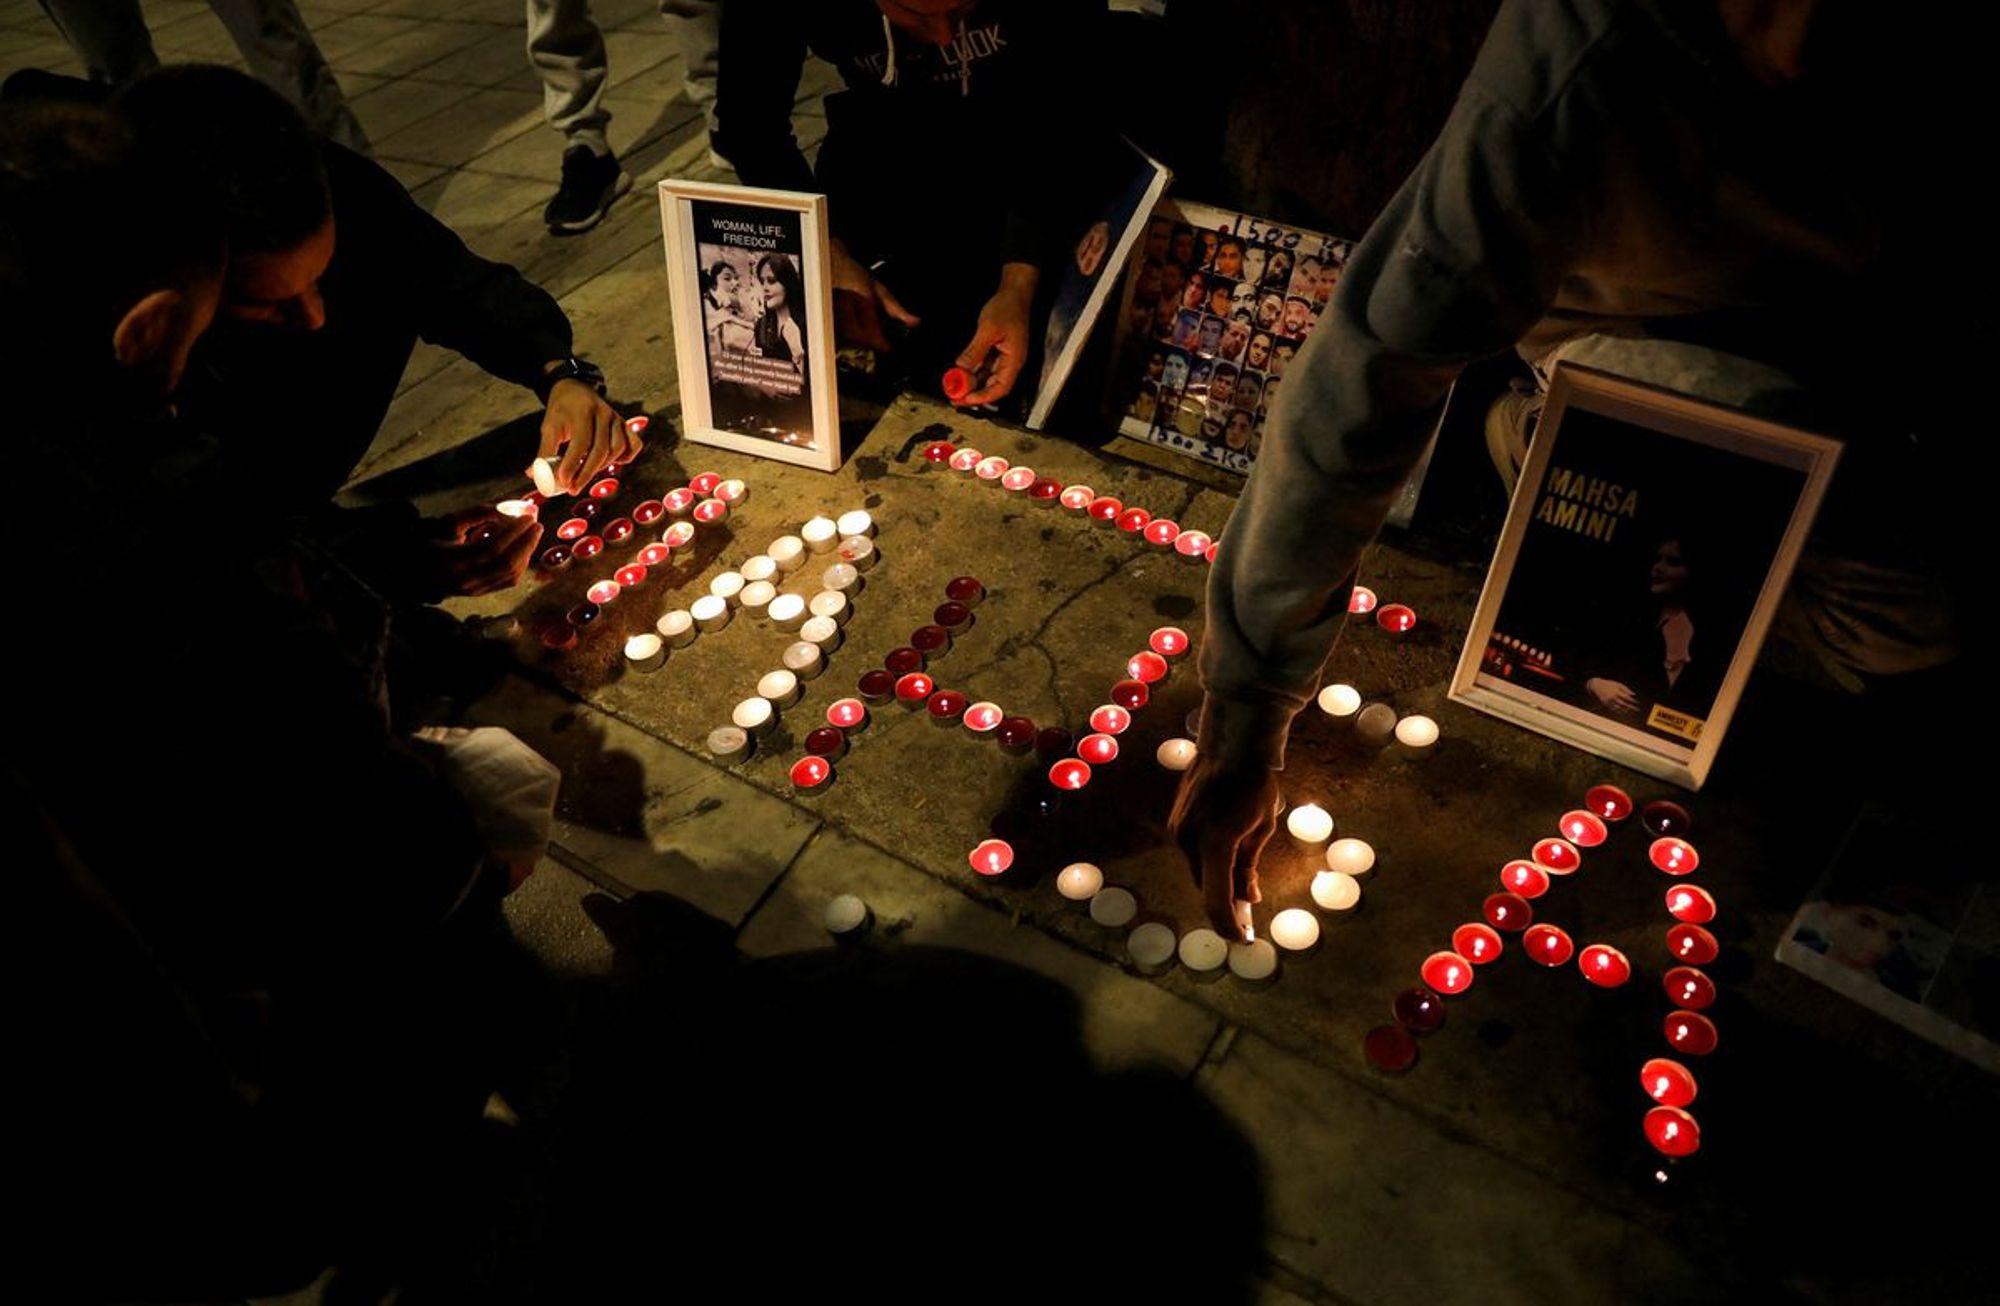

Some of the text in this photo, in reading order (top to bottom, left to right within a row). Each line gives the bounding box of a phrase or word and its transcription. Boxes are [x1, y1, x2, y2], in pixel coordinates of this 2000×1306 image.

[711, 218, 786, 239] WOMAN, LIFE,
[722, 233, 777, 249] FREEDOM
[1546, 465, 1639, 519] MAHSA
[1536, 496, 1618, 543] AMINI
